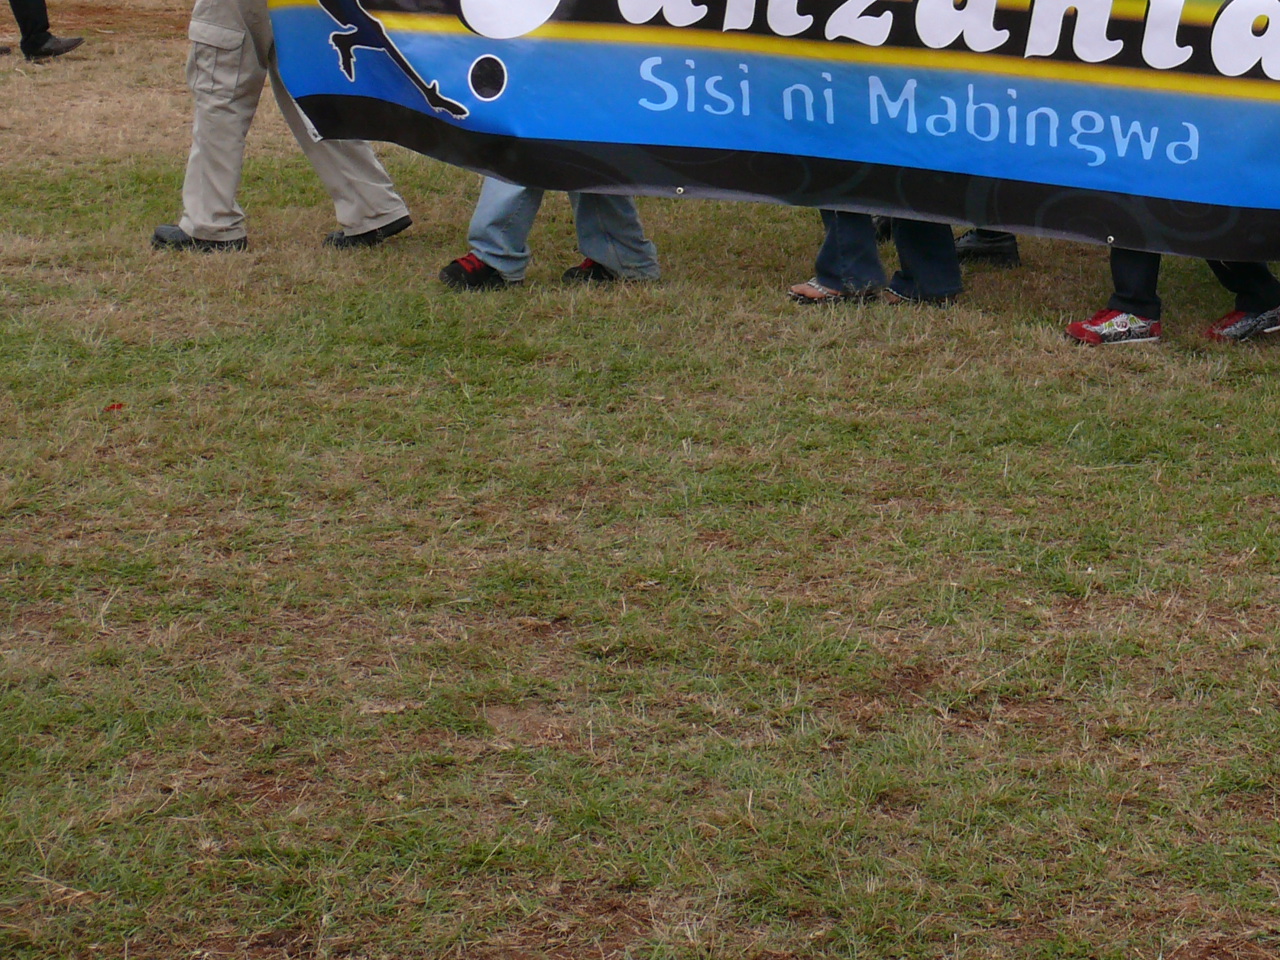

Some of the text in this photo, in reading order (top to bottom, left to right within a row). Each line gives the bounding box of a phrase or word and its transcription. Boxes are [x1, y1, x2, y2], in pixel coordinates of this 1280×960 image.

[638, 56, 1200, 167] Sisi ni Mabingwa
